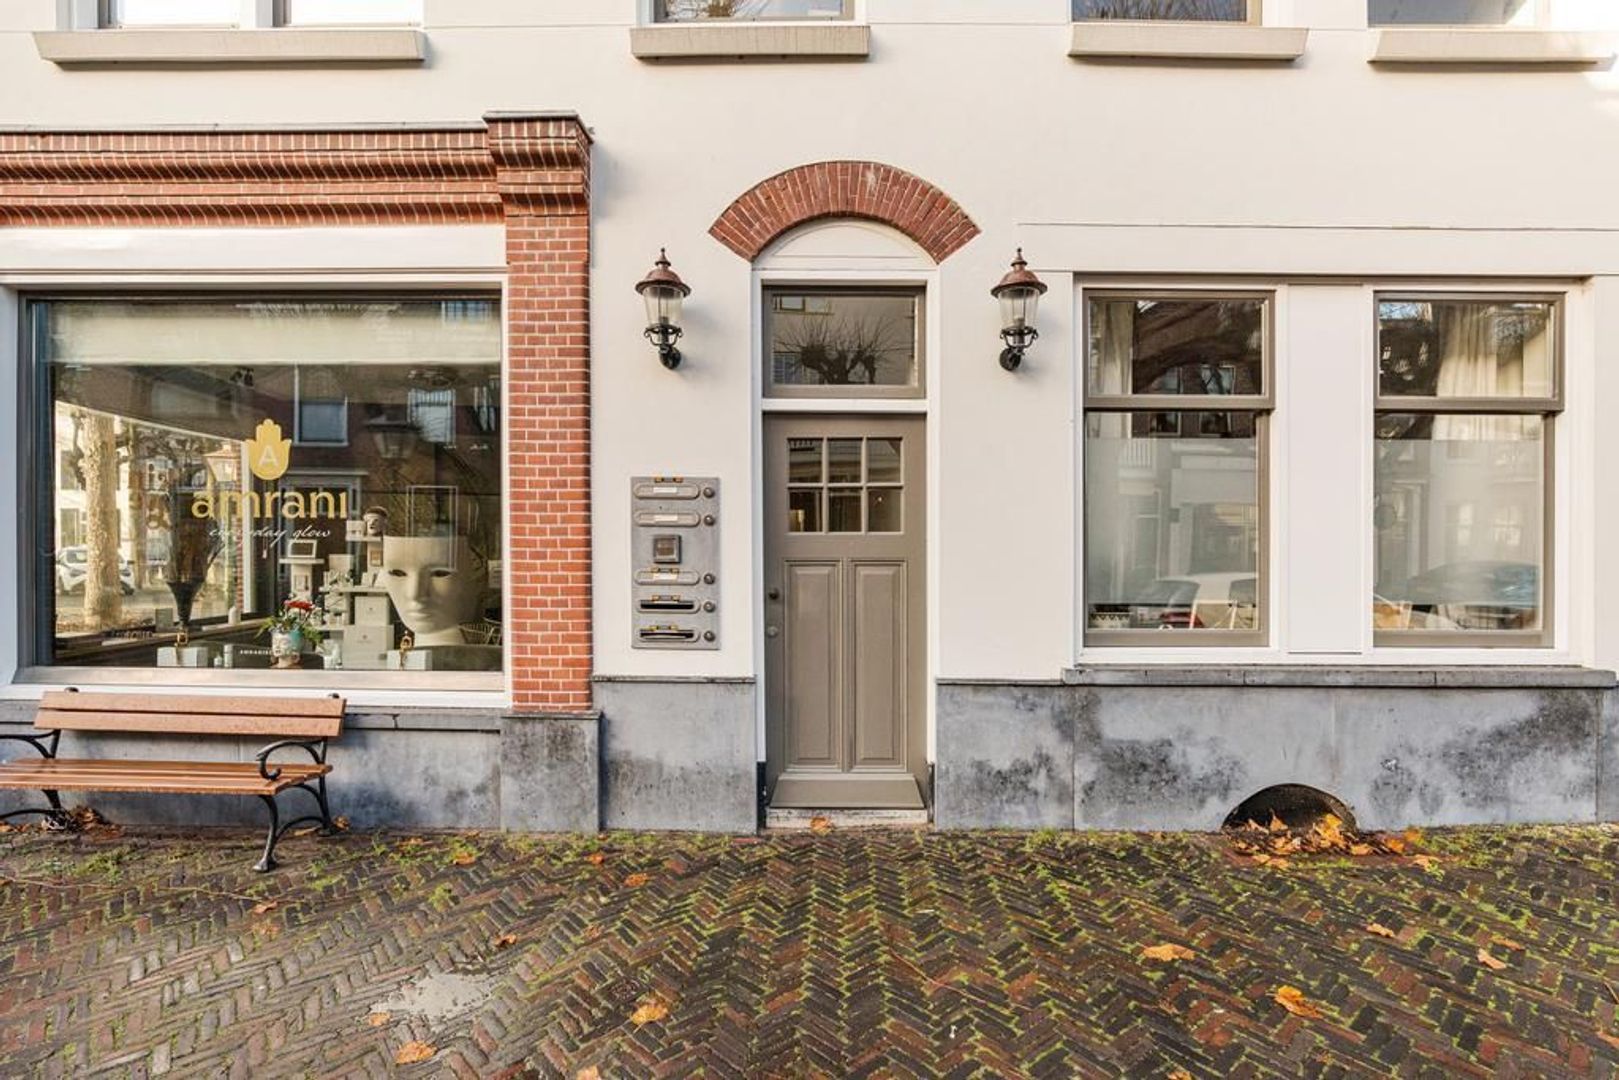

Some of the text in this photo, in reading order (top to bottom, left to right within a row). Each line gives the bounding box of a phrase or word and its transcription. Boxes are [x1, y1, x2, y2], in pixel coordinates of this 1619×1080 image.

[258, 445, 280, 467] A
[191, 490, 348, 519] amrani
[209, 524, 332, 548] evday glow
